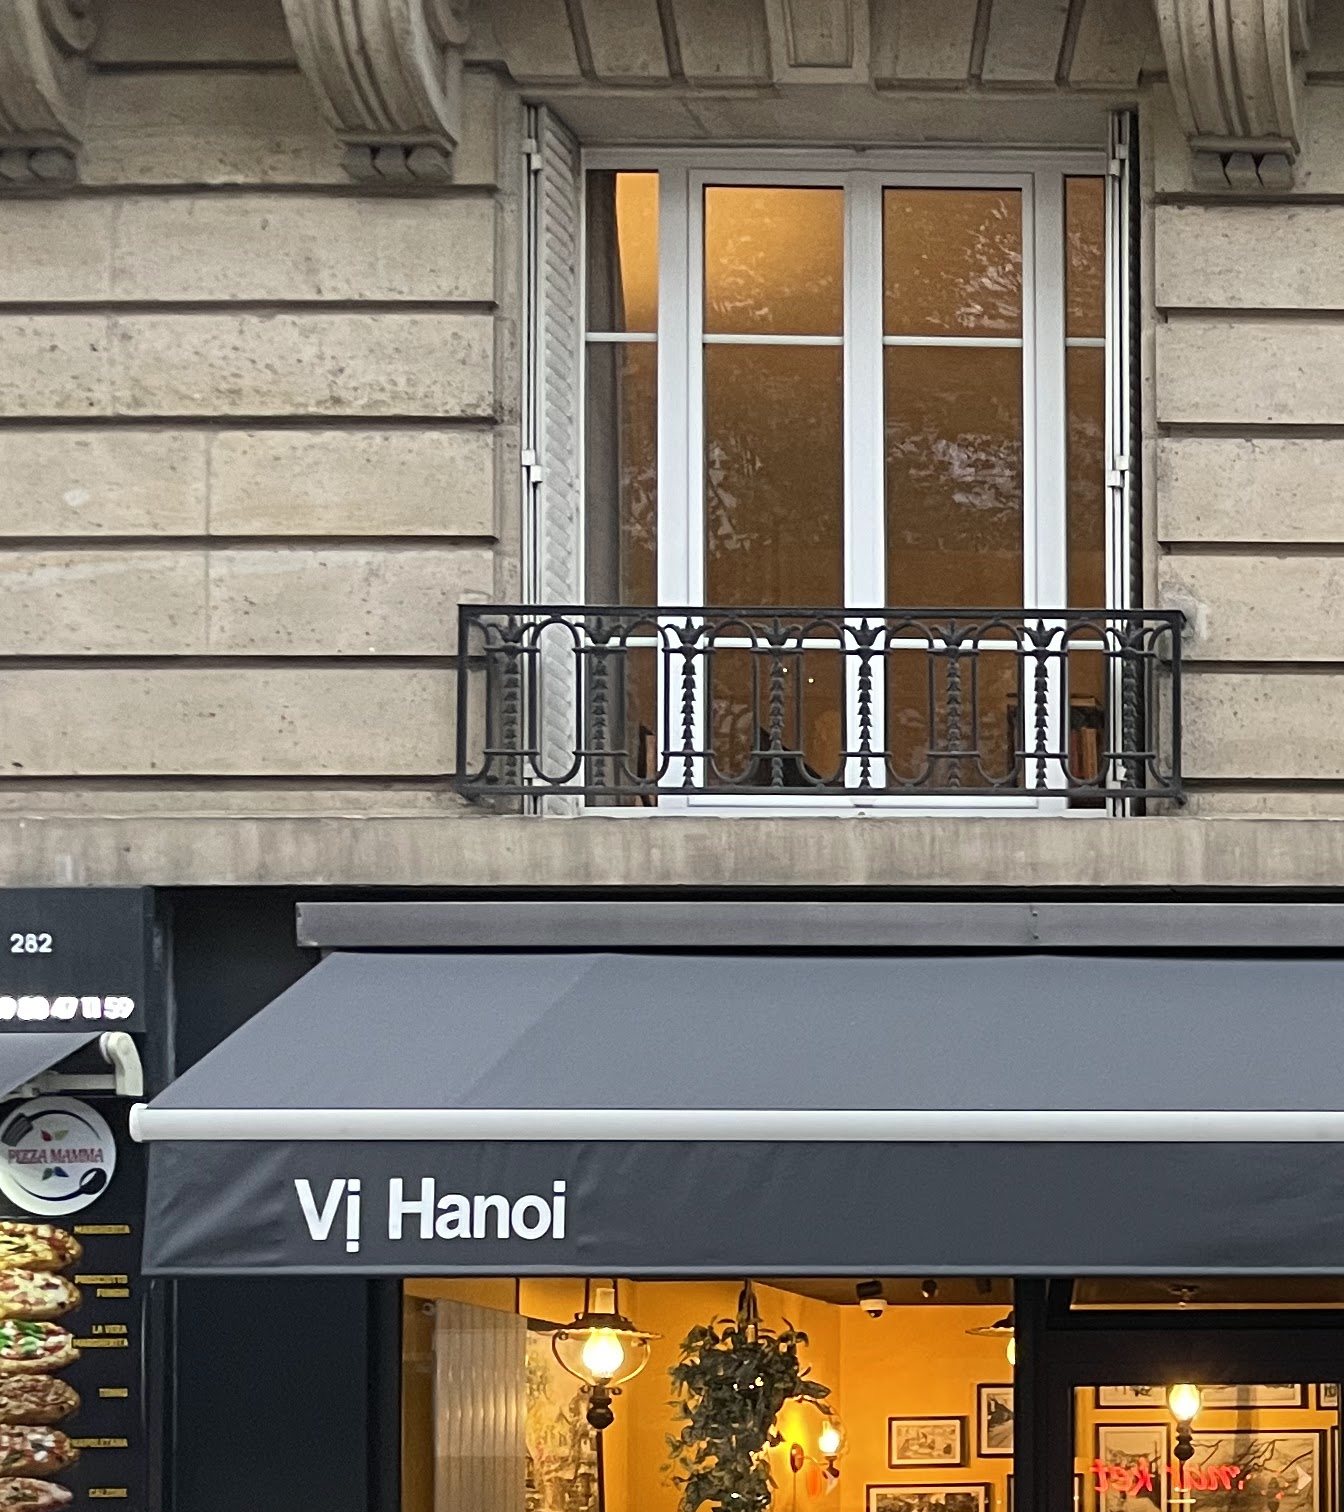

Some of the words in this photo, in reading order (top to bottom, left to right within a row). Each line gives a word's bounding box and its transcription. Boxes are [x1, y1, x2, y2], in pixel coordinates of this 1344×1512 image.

[10, 933, 53, 954] 282
[8, 1149, 47, 1164] PIZZA
[294, 1178, 361, 1253] Vị
[388, 1177, 567, 1240] Hanoi
